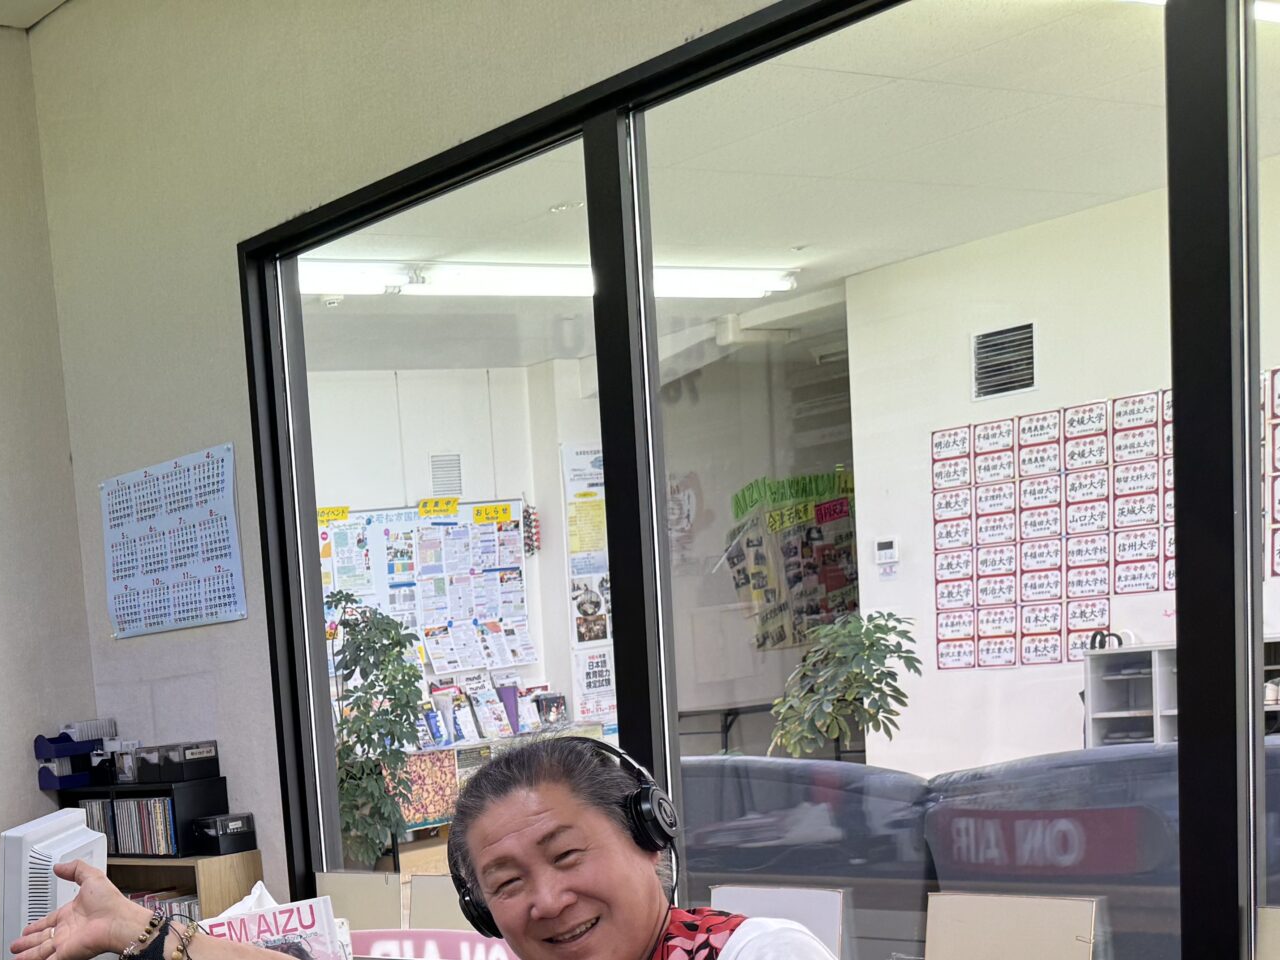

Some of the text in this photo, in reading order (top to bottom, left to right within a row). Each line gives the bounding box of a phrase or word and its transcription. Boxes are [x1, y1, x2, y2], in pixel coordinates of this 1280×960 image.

[1025, 614, 1059, 623] 日本大学
[1025, 644, 1059, 654] 日本大学
[257, 904, 316, 939] AIZU
